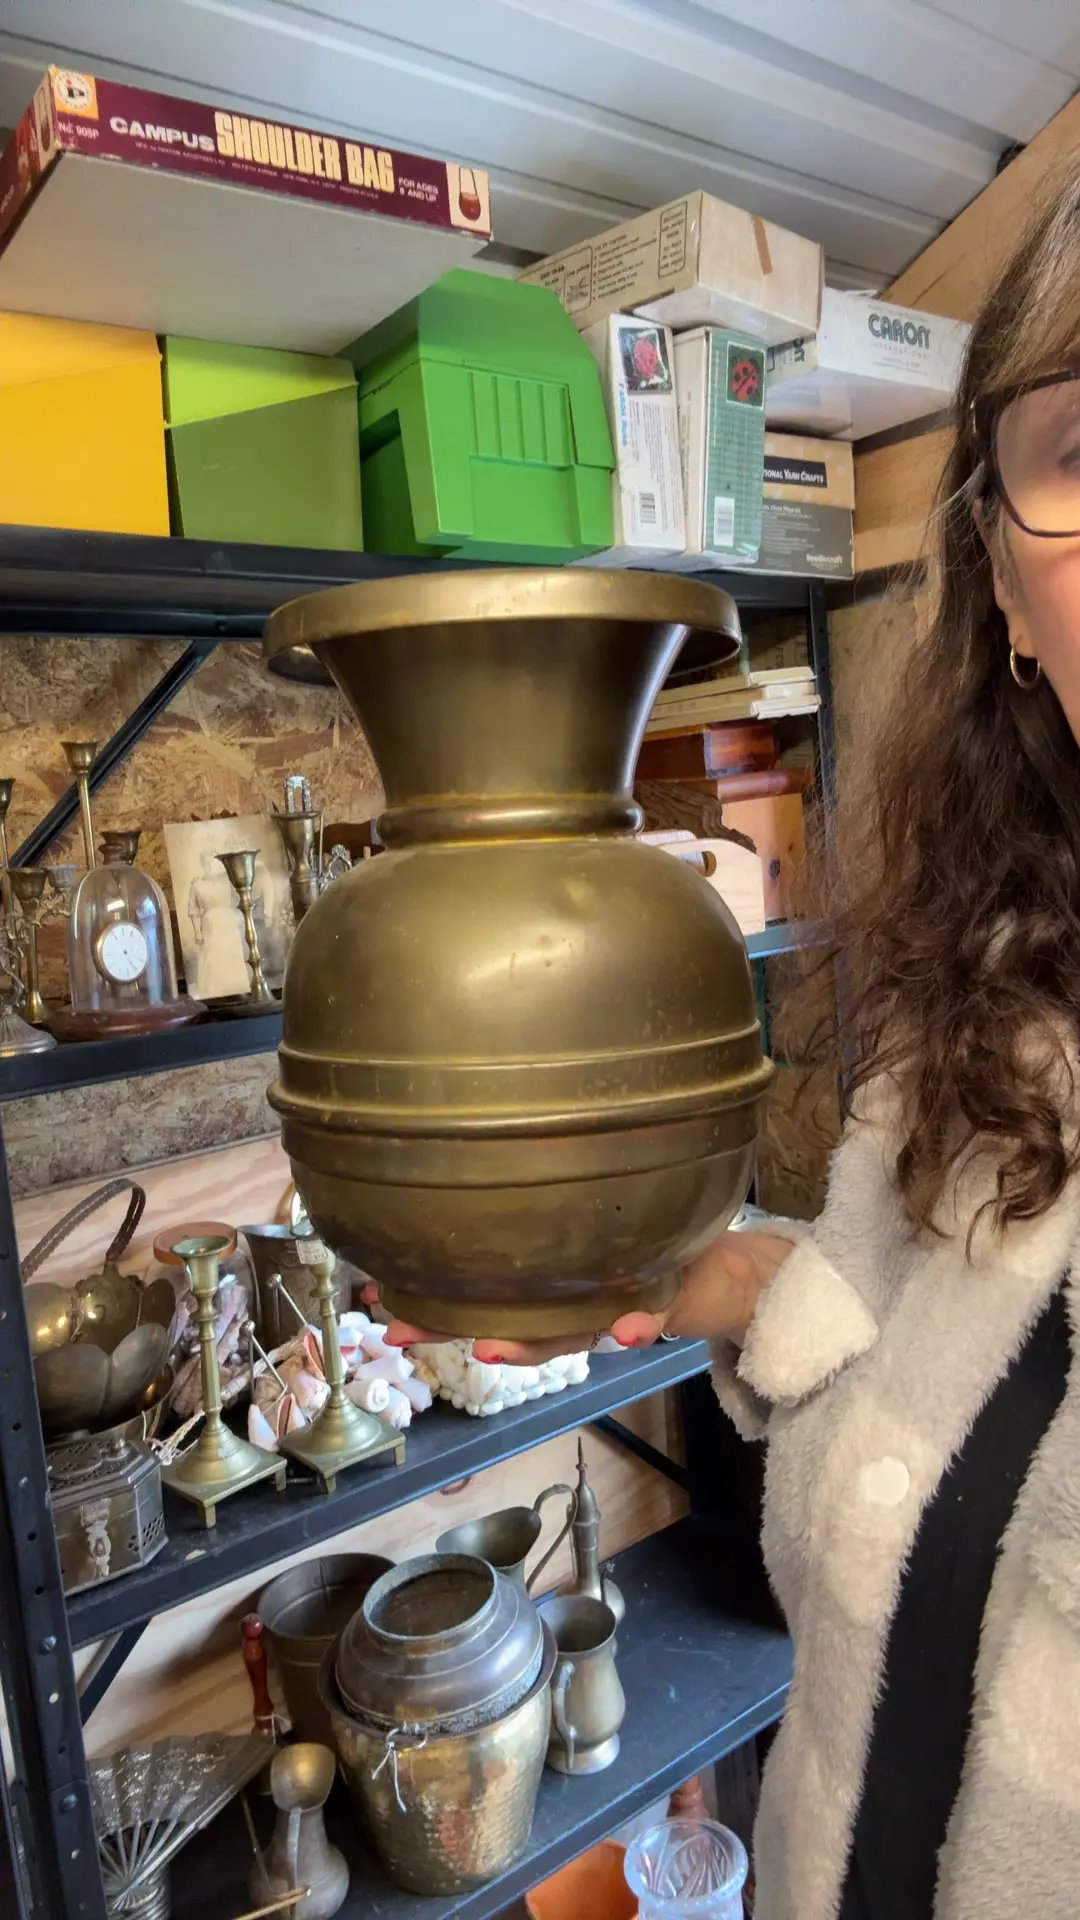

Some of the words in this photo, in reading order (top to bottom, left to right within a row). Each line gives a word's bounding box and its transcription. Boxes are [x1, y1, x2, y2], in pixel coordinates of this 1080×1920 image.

[109, 116, 215, 152] CAMPUS
[214, 111, 342, 181] SHOULDER
[345, 142, 395, 193] BAG
[399, 177, 415, 188] FOR
[416, 182, 439, 195] AGES
[407, 189, 425, 200] AND
[425, 192, 437, 202] UP
[868, 313, 931, 350] CARON
[784, 469, 800, 480] YARN
[801, 471, 824, 483] CRAFTS
